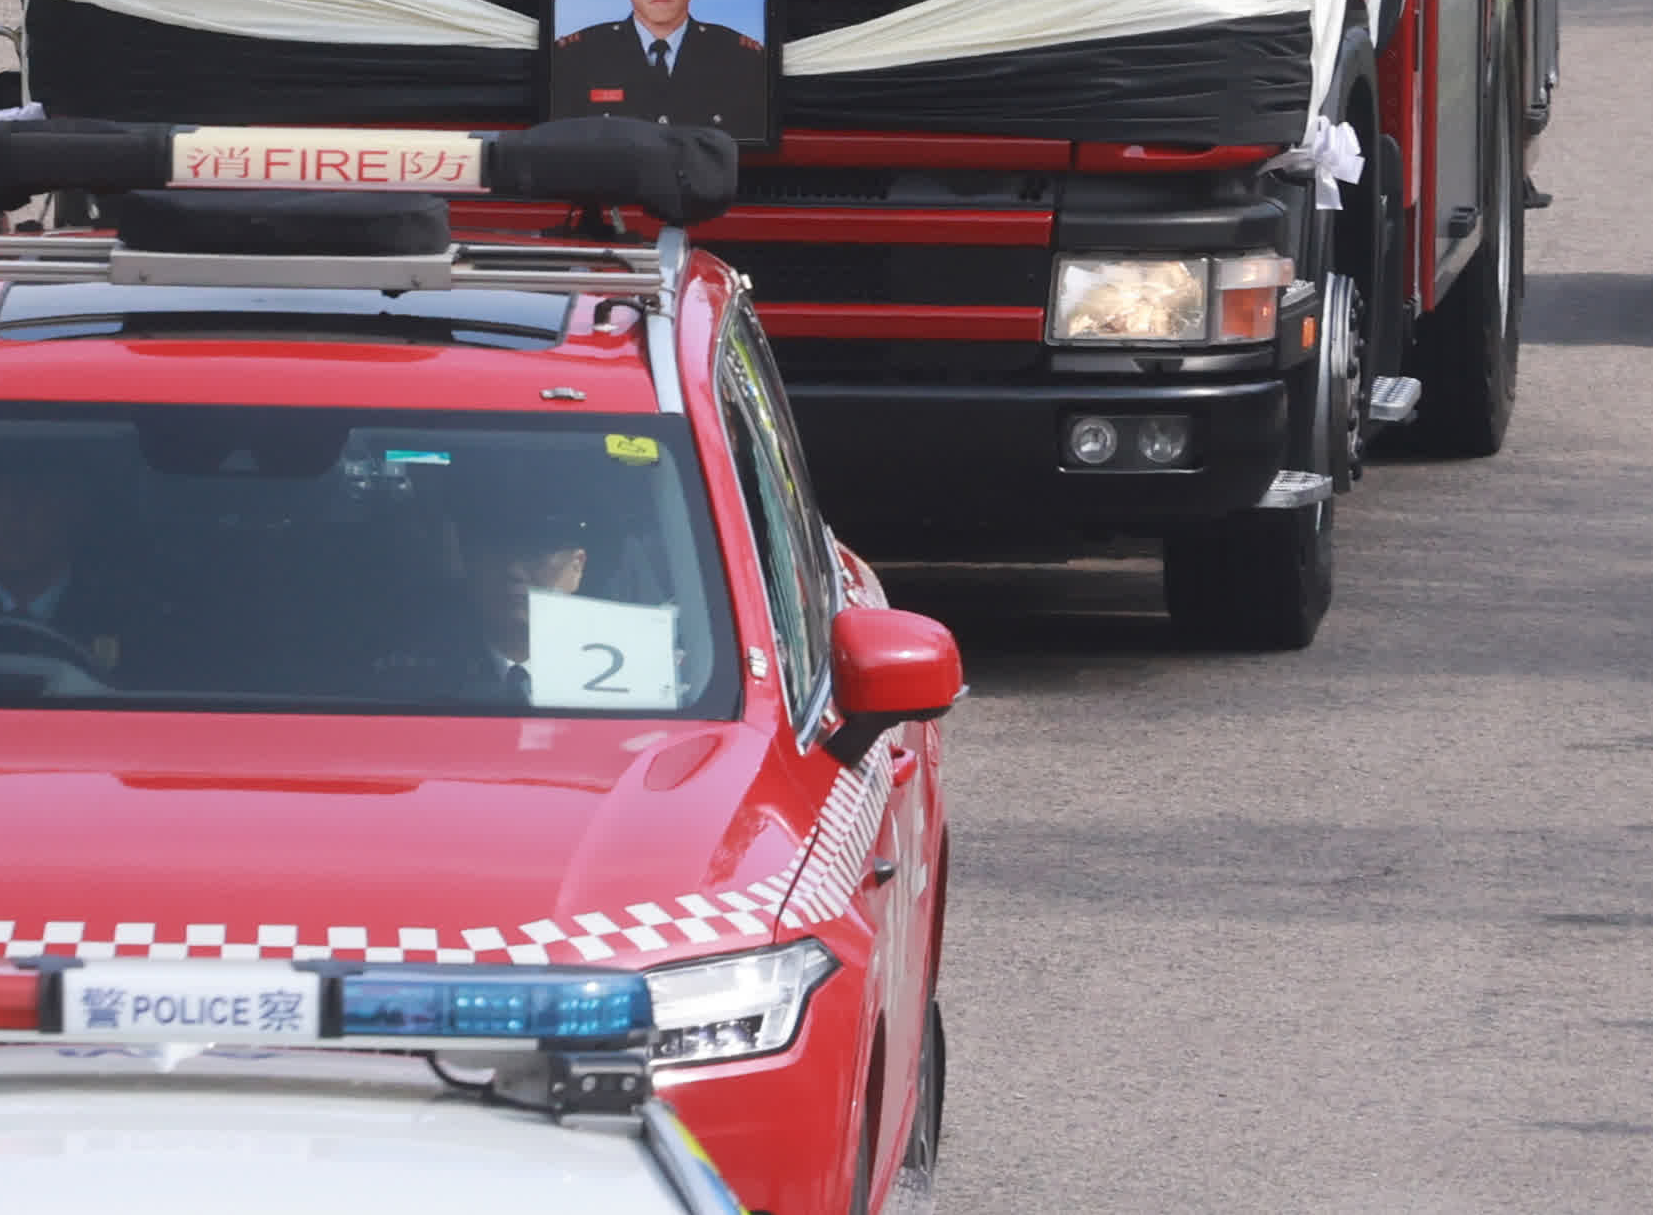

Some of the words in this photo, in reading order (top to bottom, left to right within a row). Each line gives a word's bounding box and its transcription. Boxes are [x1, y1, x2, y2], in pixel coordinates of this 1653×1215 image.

[186, 146, 251, 179] 消
[263, 148, 390, 183] FIRE
[400, 150, 473, 182] 防
[581, 643, 630, 693] 2
[81, 987, 124, 1029] 警
[131, 994, 251, 1027] POLICE
[258, 990, 304, 1032] 察
